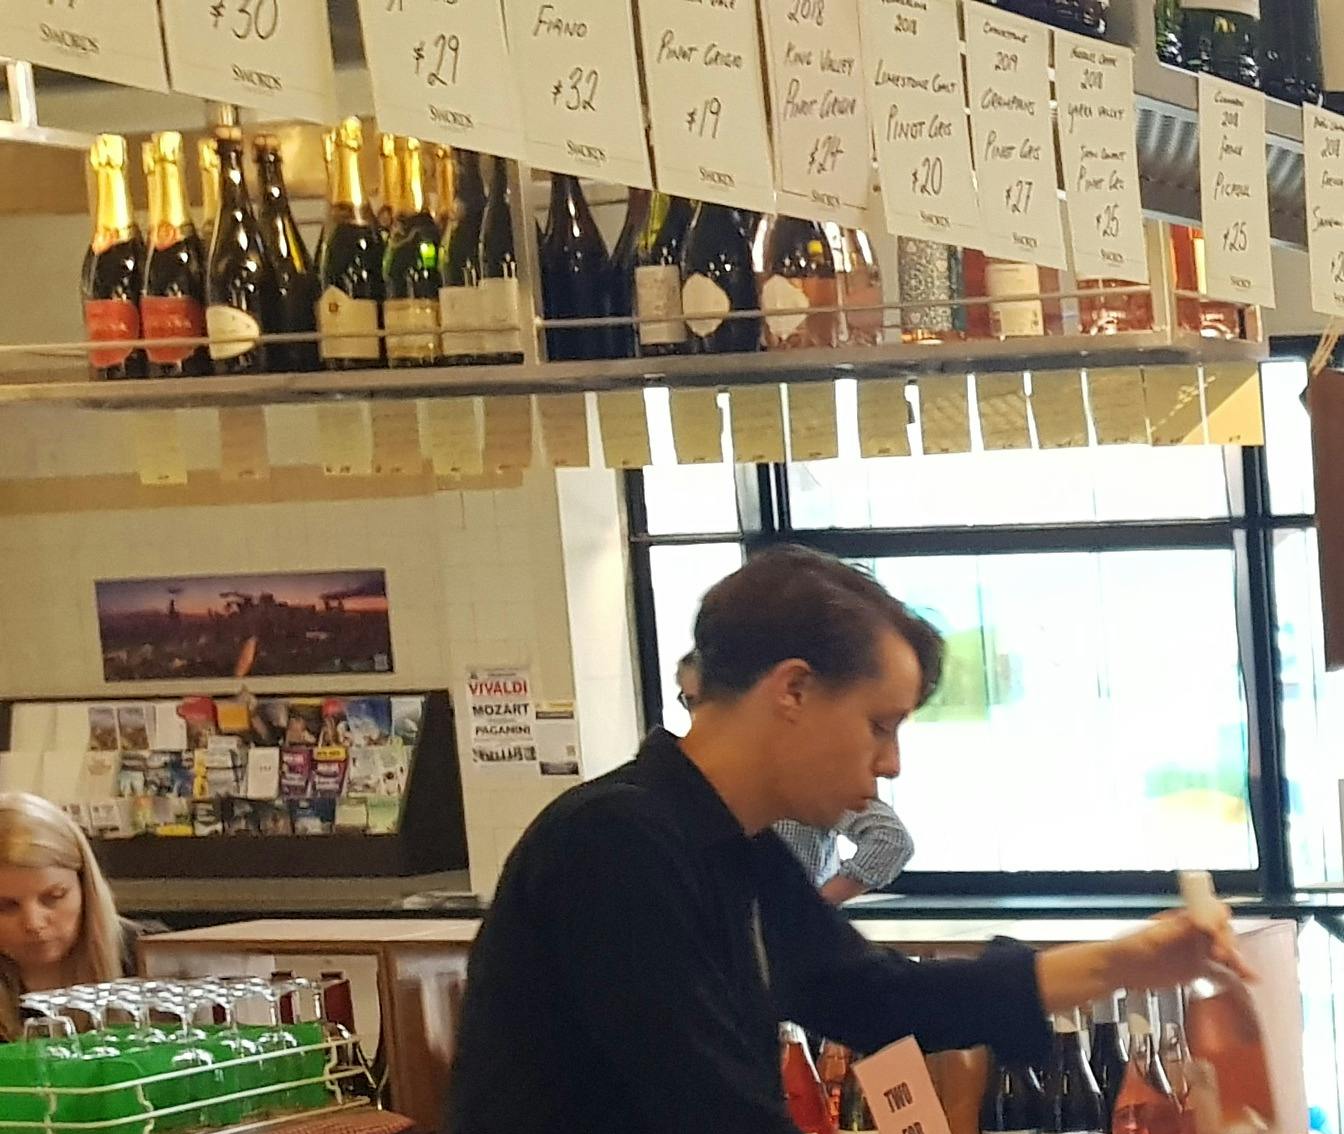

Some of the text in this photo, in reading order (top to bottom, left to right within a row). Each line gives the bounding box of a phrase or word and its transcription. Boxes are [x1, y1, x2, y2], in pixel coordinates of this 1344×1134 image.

[413, 34, 460, 87] $29
[551, 67, 599, 111] $32
[686, 97, 722, 139] $19
[886, 104, 926, 142] PINOT
[911, 156, 943, 197] $20
[468, 680, 528, 696] VIVALDI
[472, 703, 530, 717] MOZART
[475, 725, 531, 737] PAGANINI
[883, 1081, 913, 1113] TWO
